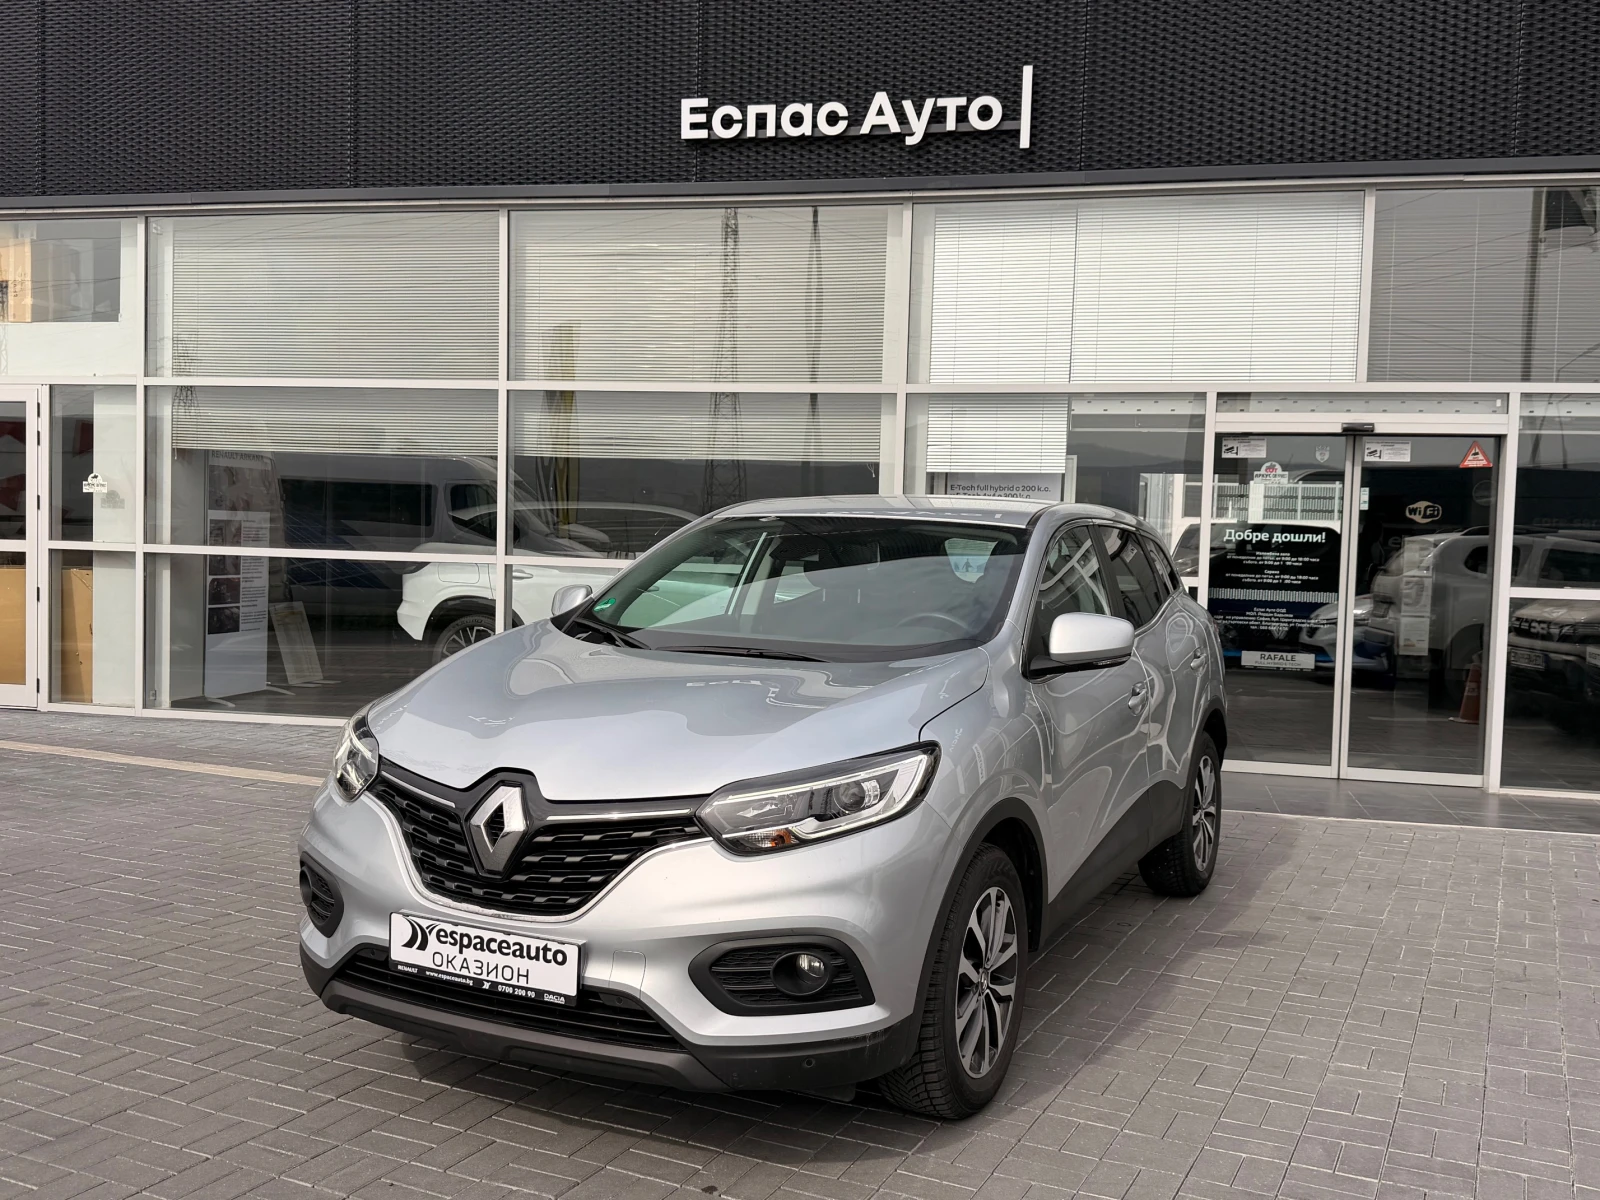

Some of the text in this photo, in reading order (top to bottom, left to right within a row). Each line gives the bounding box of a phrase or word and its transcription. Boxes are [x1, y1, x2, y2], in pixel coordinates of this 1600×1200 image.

[680, 91, 1003, 145] Еспас Ауто
[950, 484, 975, 492] E-Tech
[976, 484, 988, 492] full
[990, 485, 1015, 493] hybrid
[1223, 529, 1326, 543] Добре дошли!
[1260, 653, 1296, 662] RAFALE
[435, 927, 568, 966] espaceauto
[397, 964, 419, 974] RENAULT
[425, 970, 474, 986] www.espaceauto.bg
[498, 984, 513, 994] 0700
[514, 987, 526, 996] 200
[527, 990, 536, 998] 90
[544, 993, 565, 1002] DACIA
[432, 951, 530, 984] ОКАЗИОН
